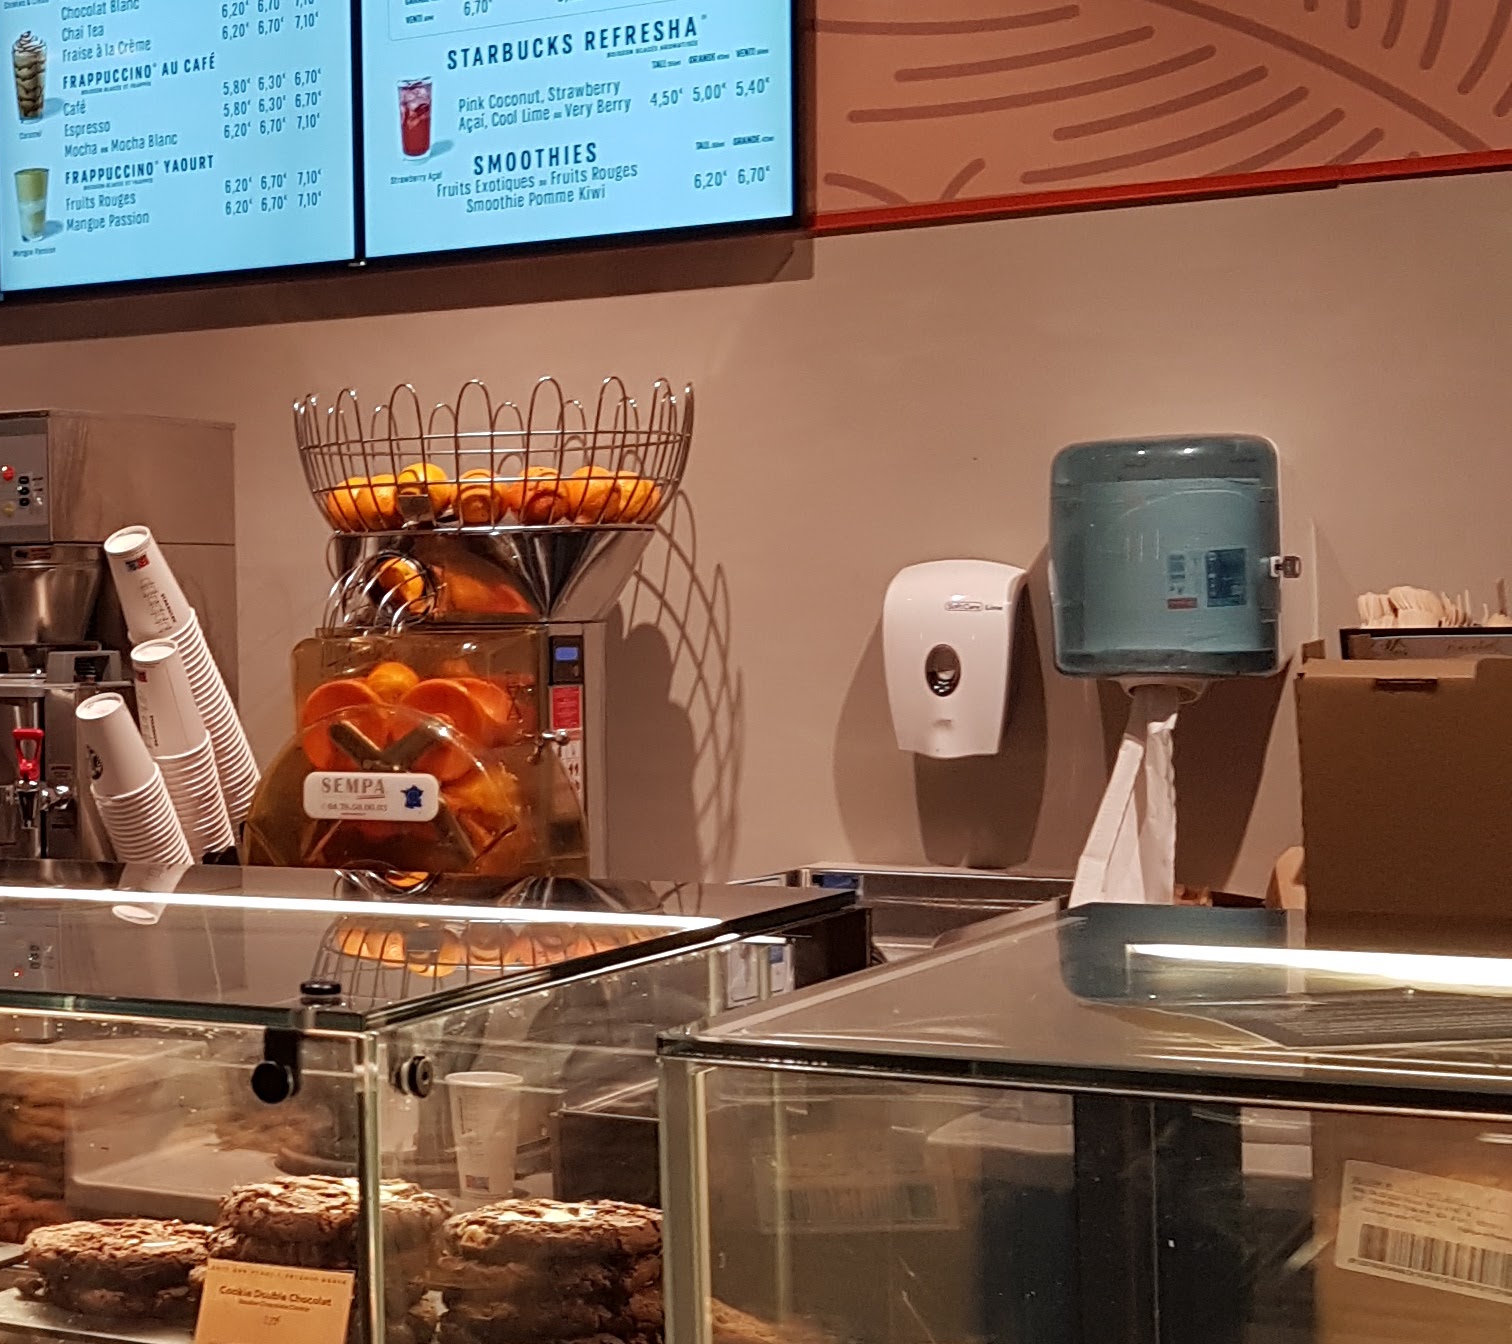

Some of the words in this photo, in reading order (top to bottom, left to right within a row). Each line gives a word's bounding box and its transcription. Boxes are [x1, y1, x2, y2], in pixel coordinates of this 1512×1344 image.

[61, 1, 107, 21] Chocolat
[62, 26, 84, 42] Chai
[88, 23, 104, 38] Tea
[447, 33, 573, 71] STARBUCKS
[585, 16, 697, 51] REFRESHA
[162, 59, 178, 77] AU
[184, 52, 215, 73] CAFÉ
[459, 97, 484, 113] Pink
[489, 91, 545, 109] Coconut,
[548, 81, 621, 104] Strawberry
[63, 100, 86, 117] Café
[492, 109, 519, 127] Cool
[522, 106, 550, 122] Lime
[565, 103, 592, 121] Very
[597, 97, 631, 116] Berry
[64, 121, 111, 138] Espresso
[164, 155, 214, 174] YAOURT
[474, 143, 597, 176] SMOOTHIES
[437, 179, 470, 198] Fruits
[475, 171, 535, 194] Exotiques
[550, 169, 587, 186] Fruits
[592, 163, 638, 182] Rouges
[66, 194, 96, 212] Fruits
[99, 192, 136, 207] Rouges
[466, 192, 523, 213] Smoothie
[529, 186, 574, 206] Pomme
[578, 184, 605, 202] Kiwi
[66, 215, 105, 232] Mangue
[109, 210, 150, 226] Passion
[321, 778, 385, 794] SEMPA
[219, 1286, 251, 1297] Cookie
